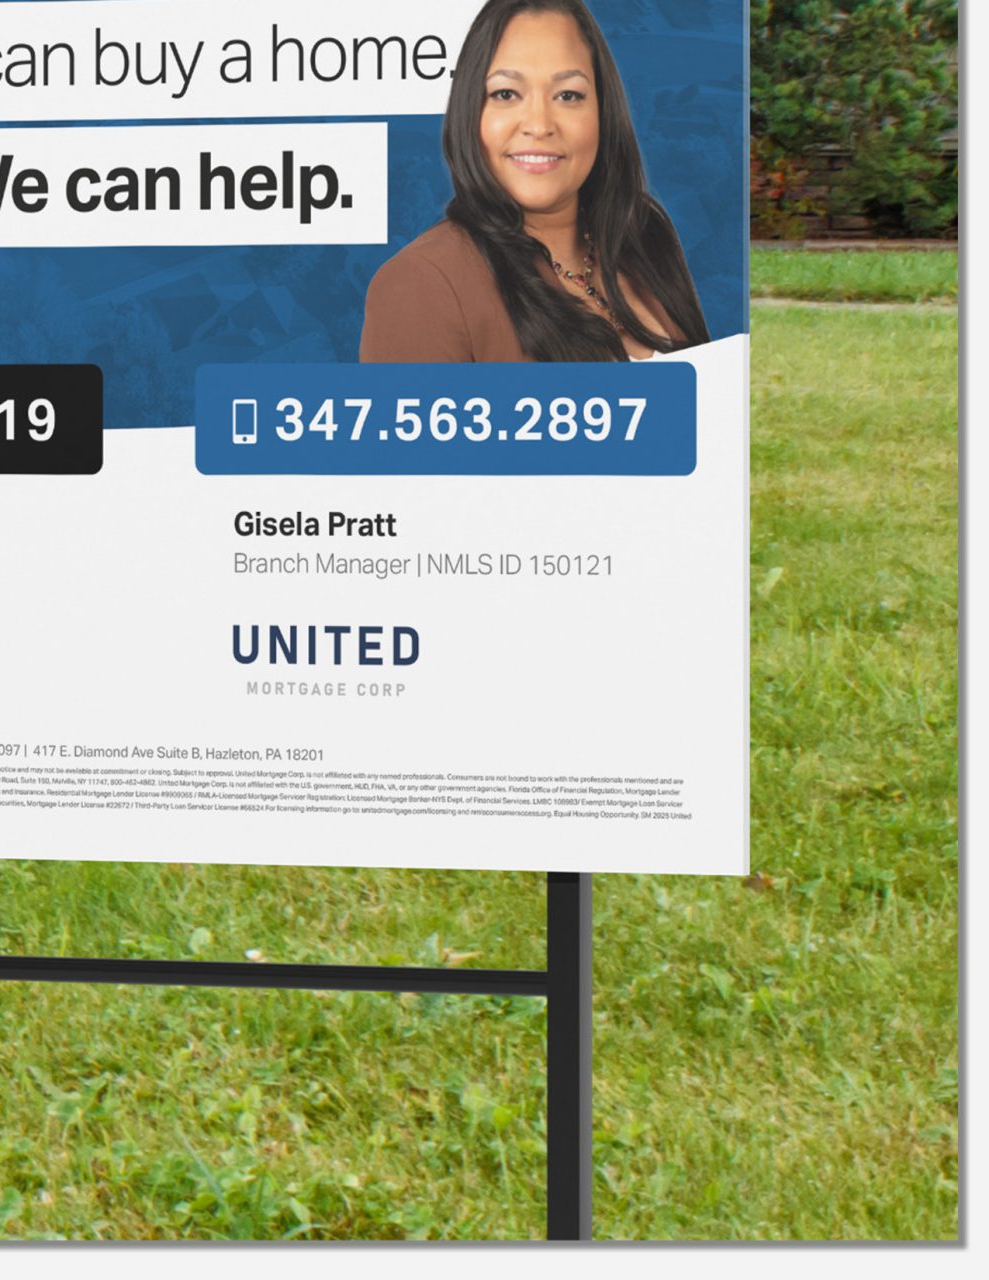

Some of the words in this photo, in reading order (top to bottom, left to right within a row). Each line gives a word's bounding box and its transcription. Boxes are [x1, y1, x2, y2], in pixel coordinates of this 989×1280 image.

[96, 28, 204, 99] buy
[220, 40, 251, 83] a
[66, 167, 180, 212] can
[200, 151, 352, 224] help.
[276, 397, 646, 441] 347.563.2897
[234, 511, 319, 536] Gisela
[329, 512, 397, 536] Pratt
[235, 553, 308, 573] Branch
[316, 553, 411, 579] Manager
[428, 554, 492, 575] NMLS
[500, 554, 521, 575] ID
[530, 555, 611, 575] 150121
[233, 625, 419, 665] UNITED
[247, 682, 346, 696] MORTGAGE
[357, 683, 405, 696] CORP
[33, 745, 56, 756] 417
[60, 745, 71, 757] E.
[74, 746, 128, 758] Diamond
[131, 746, 154, 758] Ave
[157, 746, 188, 759] Suite
[192, 747, 202, 760] B,
[206, 748, 262, 760] Hazleton,
[266, 748, 282, 760] PA
[286, 749, 322, 761] 18201
